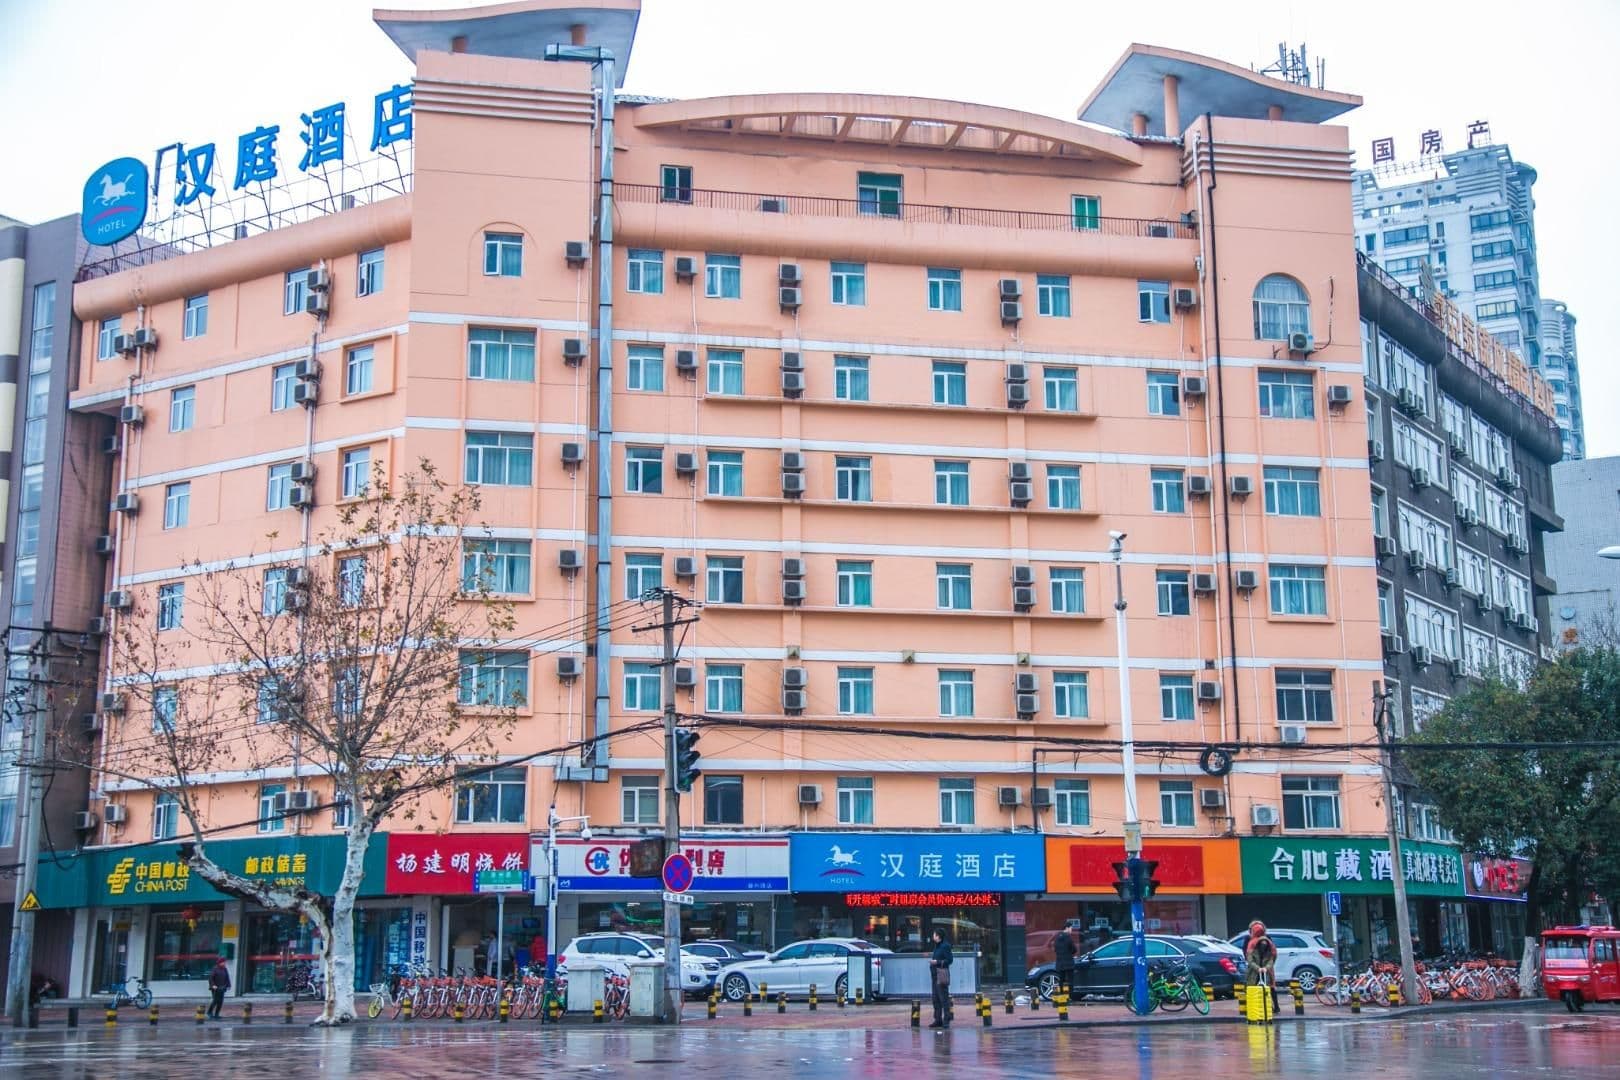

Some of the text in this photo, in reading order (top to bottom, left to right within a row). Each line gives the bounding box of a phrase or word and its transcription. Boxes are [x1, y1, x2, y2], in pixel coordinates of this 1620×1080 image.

[174, 84, 413, 206] 汉庭酒店
[98, 218, 126, 234] HOTEL
[136, 862, 190, 880] 中国邮政
[245, 853, 306, 874] 邮政储蓄
[395, 849, 524, 873] 杨建明烧饼
[880, 853, 1016, 878] 汉庭酒店
[1270, 847, 1393, 881] 合肥藏酒
[135, 878, 188, 893] CHINA POST
